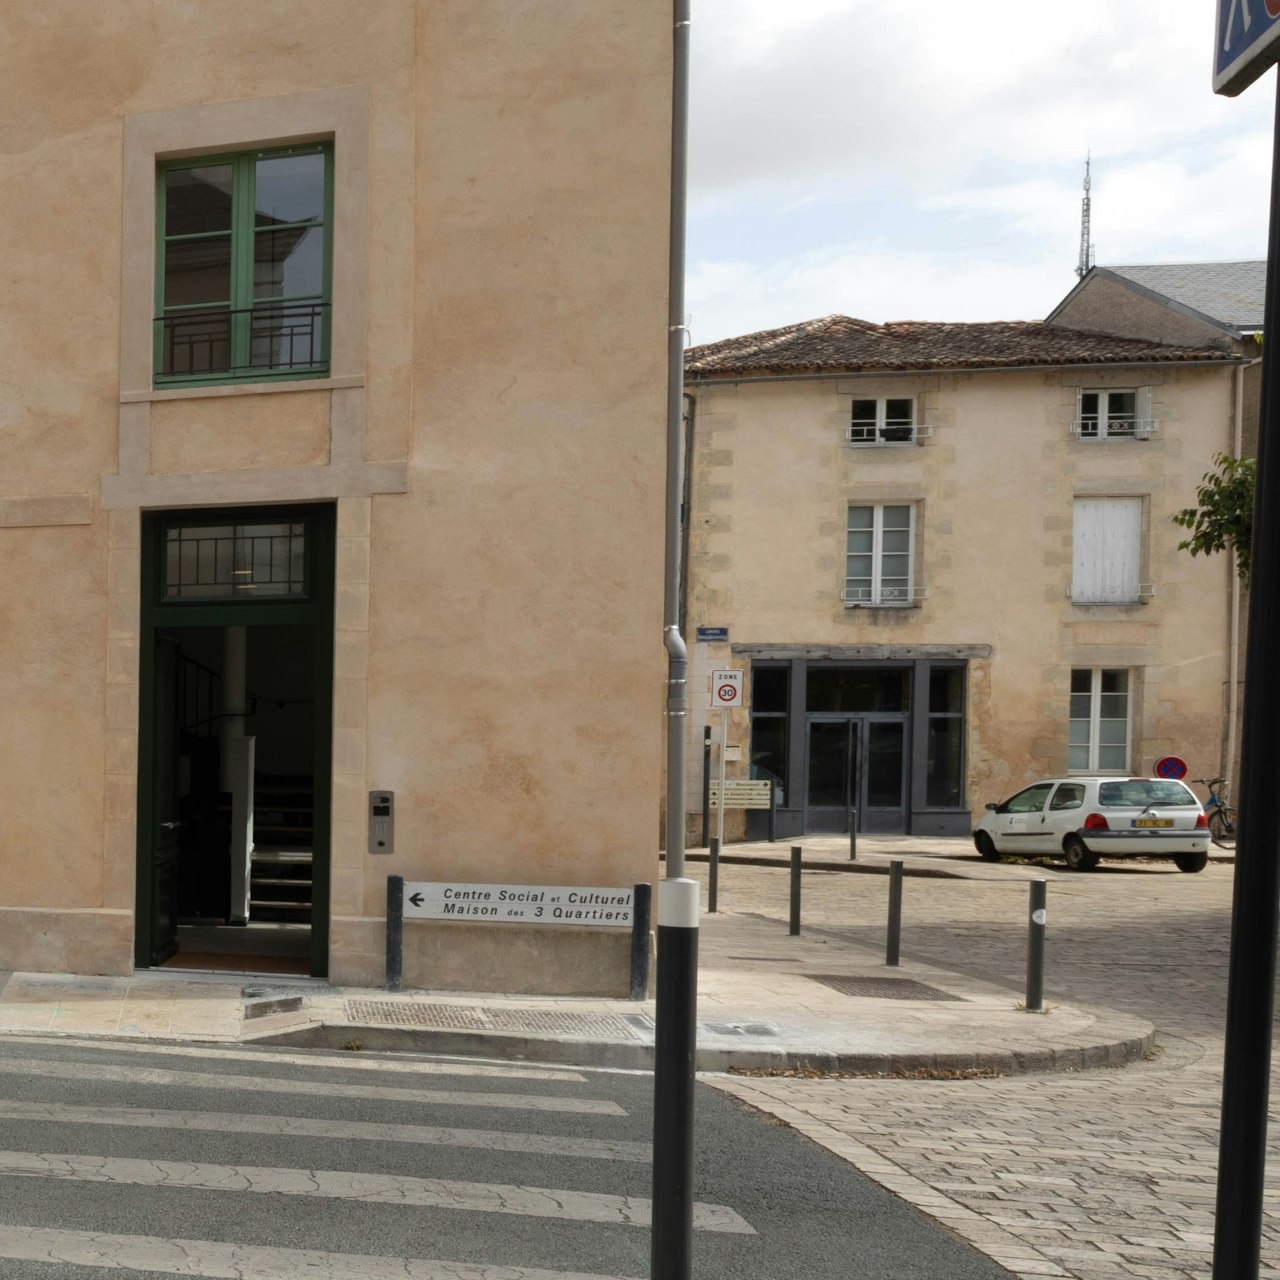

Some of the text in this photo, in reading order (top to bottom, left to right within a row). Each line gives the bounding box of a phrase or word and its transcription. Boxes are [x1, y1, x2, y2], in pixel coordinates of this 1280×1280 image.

[721, 688, 733, 697] 30
[444, 888, 491, 900] Centre
[498, 890, 544, 902] Social
[568, 892, 631, 905] Culturel
[443, 903, 629, 921] Maison des 3 Quartiers
